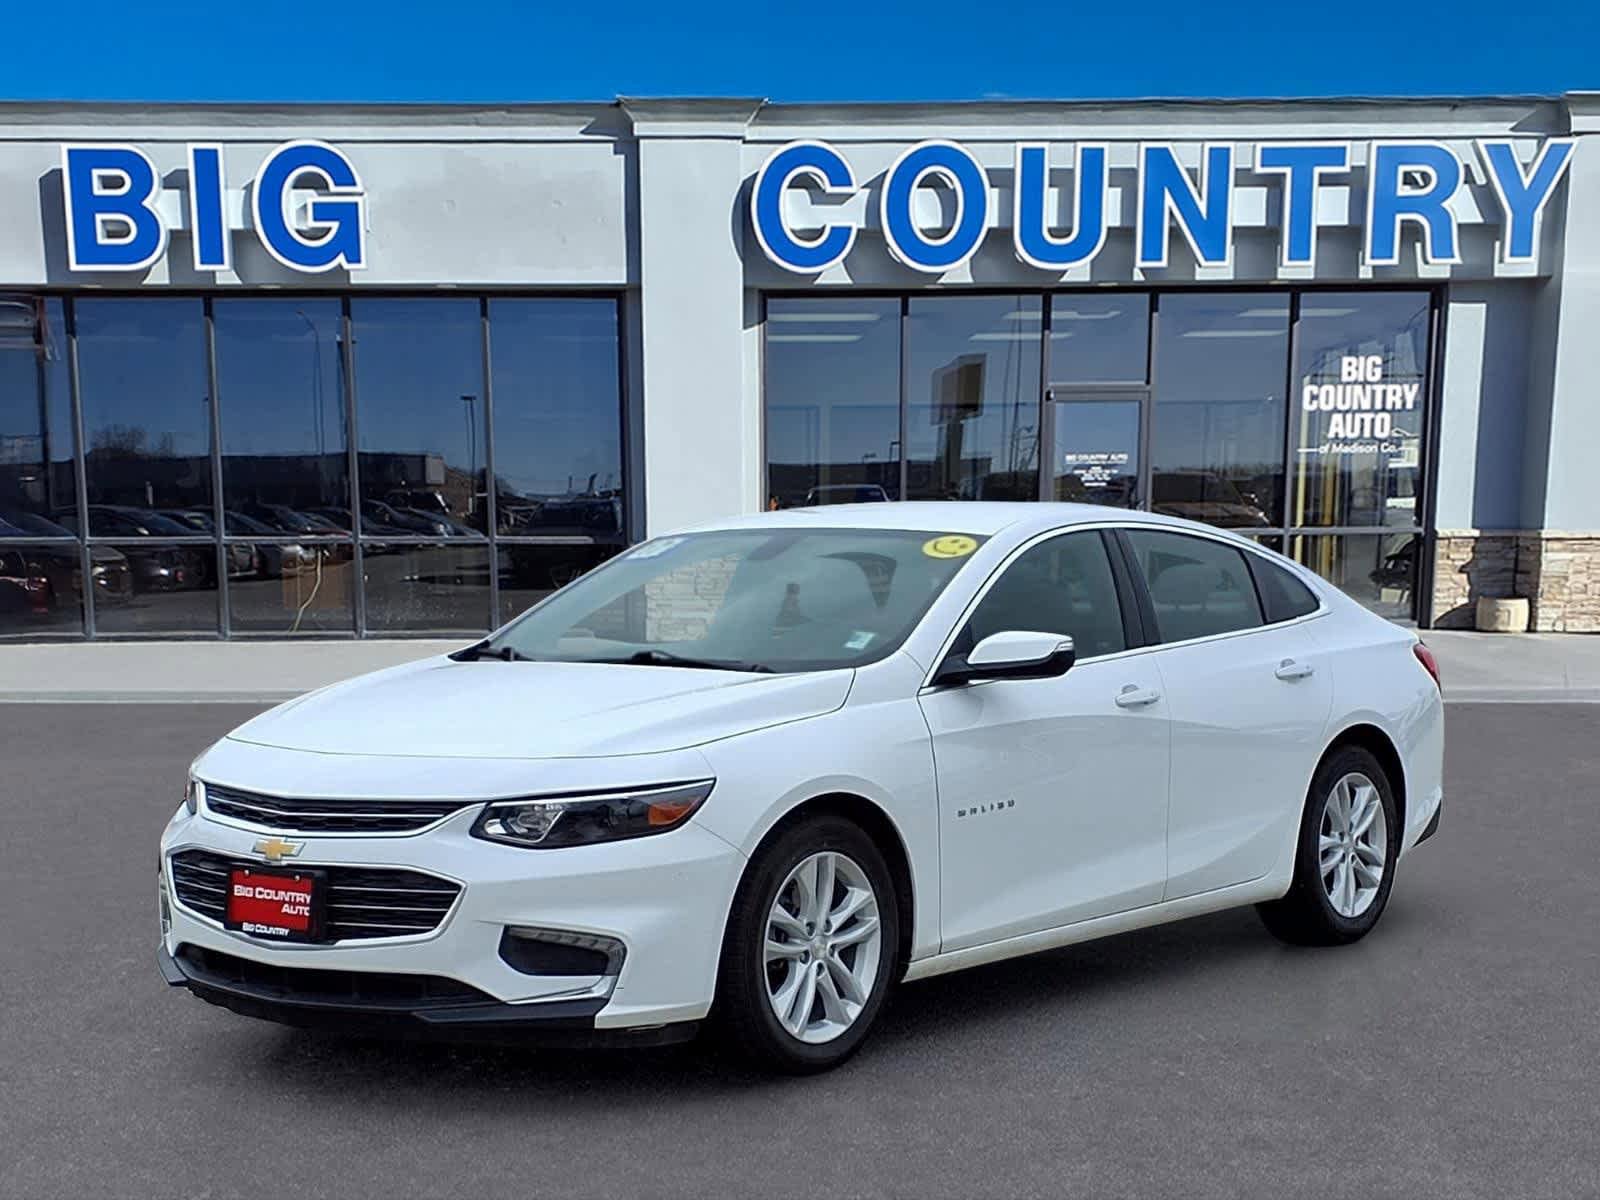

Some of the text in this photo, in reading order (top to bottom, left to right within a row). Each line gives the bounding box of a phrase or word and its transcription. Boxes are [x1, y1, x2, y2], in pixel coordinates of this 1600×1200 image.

[62, 139, 1574, 274] BIG COUNTRY
[1341, 356, 1382, 382] BIG
[1303, 384, 1419, 411] COUNTRY
[1328, 412, 1391, 439] AUTO
[1331, 443, 1378, 453] Madison
[233, 885, 311, 905] BIG COUNTRY
[256, 924, 289, 936] COUNTRY
